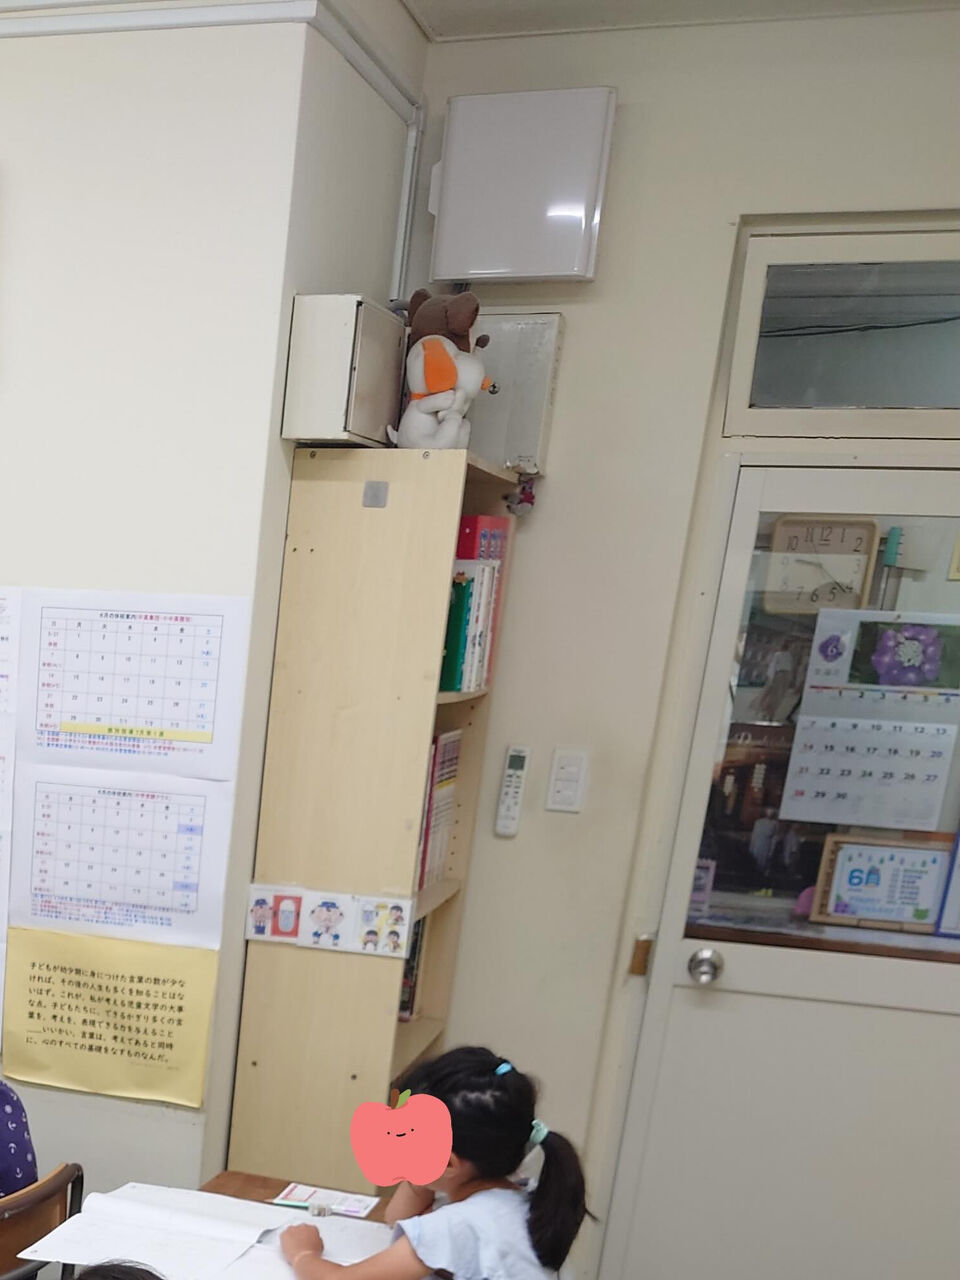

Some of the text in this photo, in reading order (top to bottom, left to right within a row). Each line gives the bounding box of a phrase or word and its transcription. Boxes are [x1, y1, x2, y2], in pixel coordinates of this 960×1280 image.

[820, 526, 832, 541] 12
[852, 537, 863, 552] 2
[810, 587, 819, 603] 6
[828, 586, 838, 602] 5
[825, 744, 834, 752] 15
[888, 748, 898, 756] 18
[909, 749, 920, 757] 19
[861, 770, 873, 778] 24
